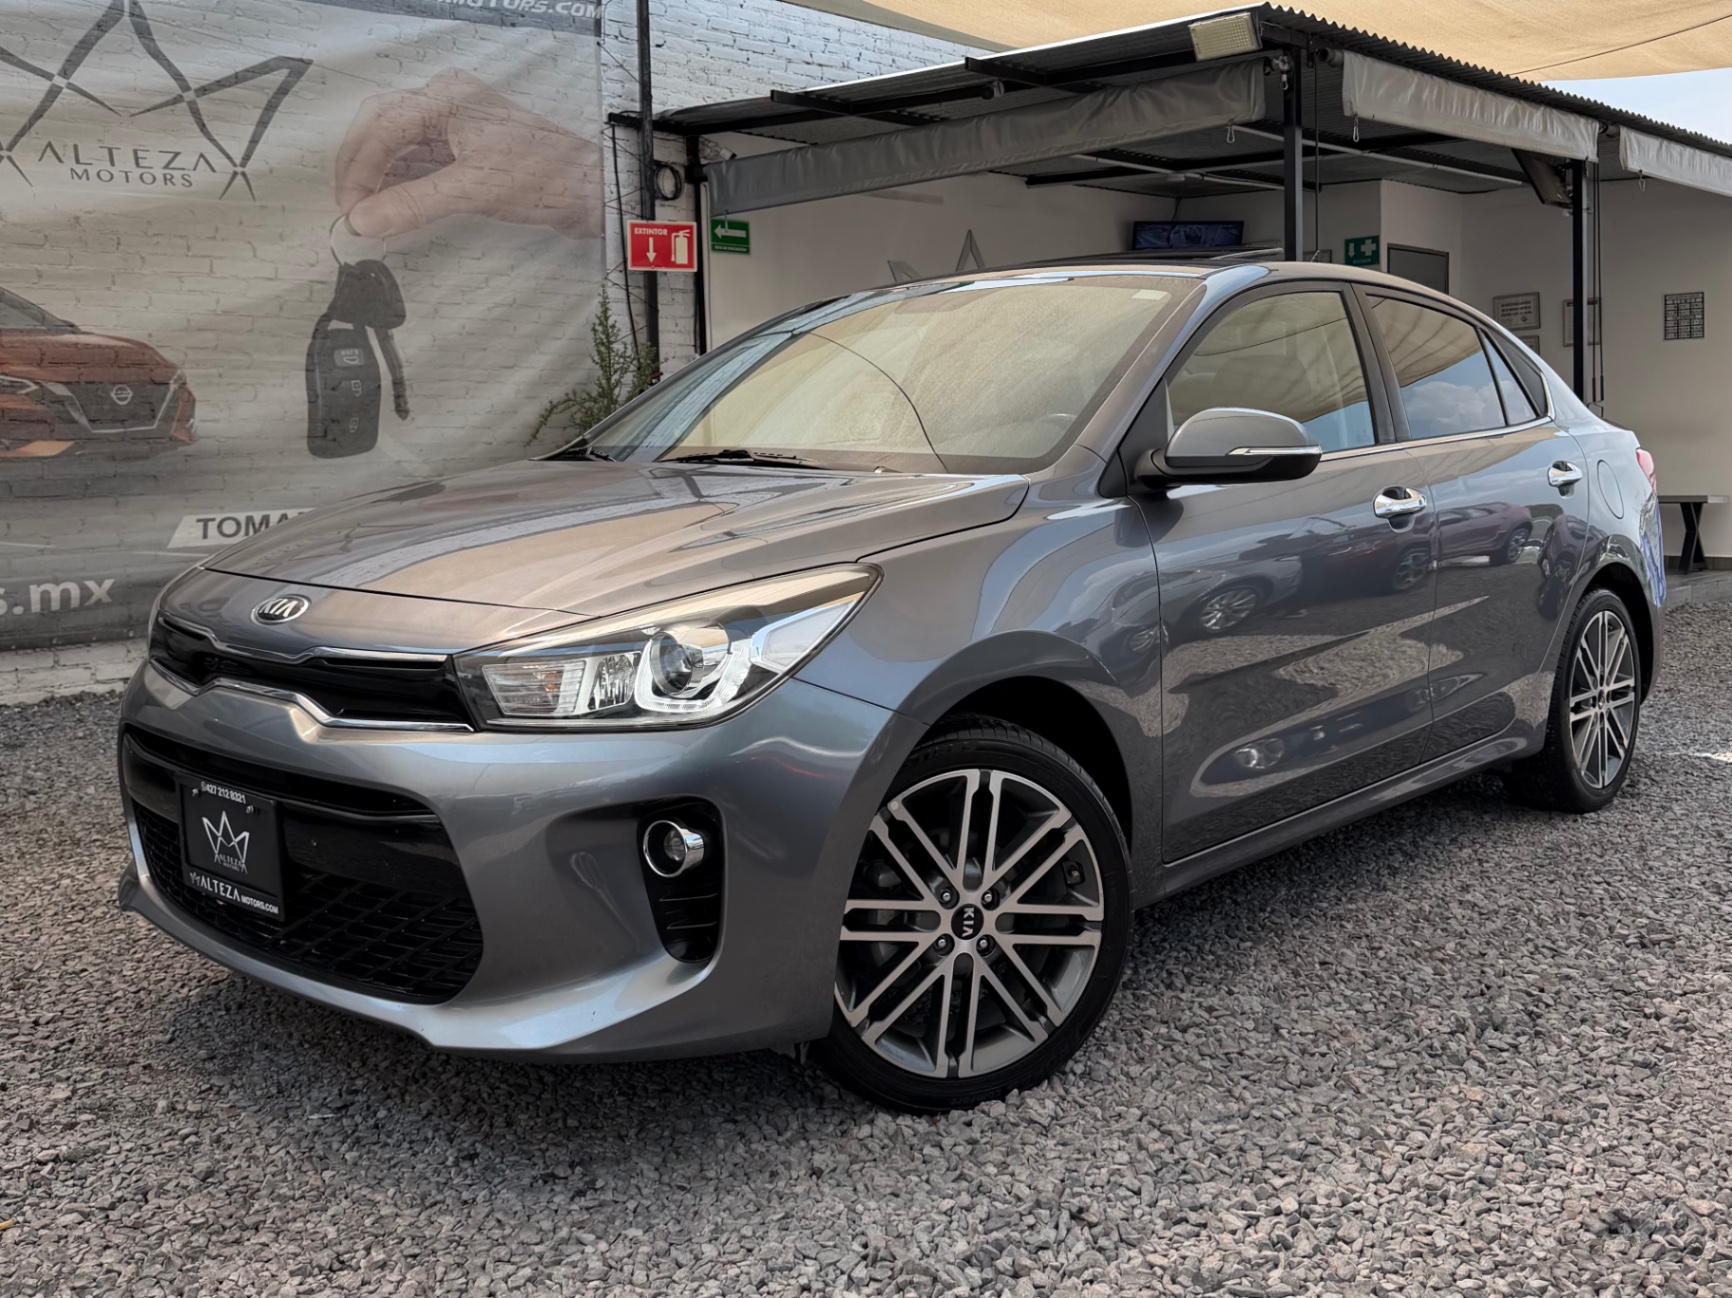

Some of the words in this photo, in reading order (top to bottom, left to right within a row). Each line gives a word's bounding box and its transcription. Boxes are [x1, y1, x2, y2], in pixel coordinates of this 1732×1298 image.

[445, 0, 602, 19] ORS.COM
[38, 140, 217, 173] ALTEZA
[70, 167, 193, 188] MOTORS
[634, 227, 668, 236] EXTINTOR
[196, 512, 305, 539] TOM
[258, 598, 299, 618] KIA
[201, 875, 240, 902] ALTEZA
[961, 907, 975, 937] KIA
